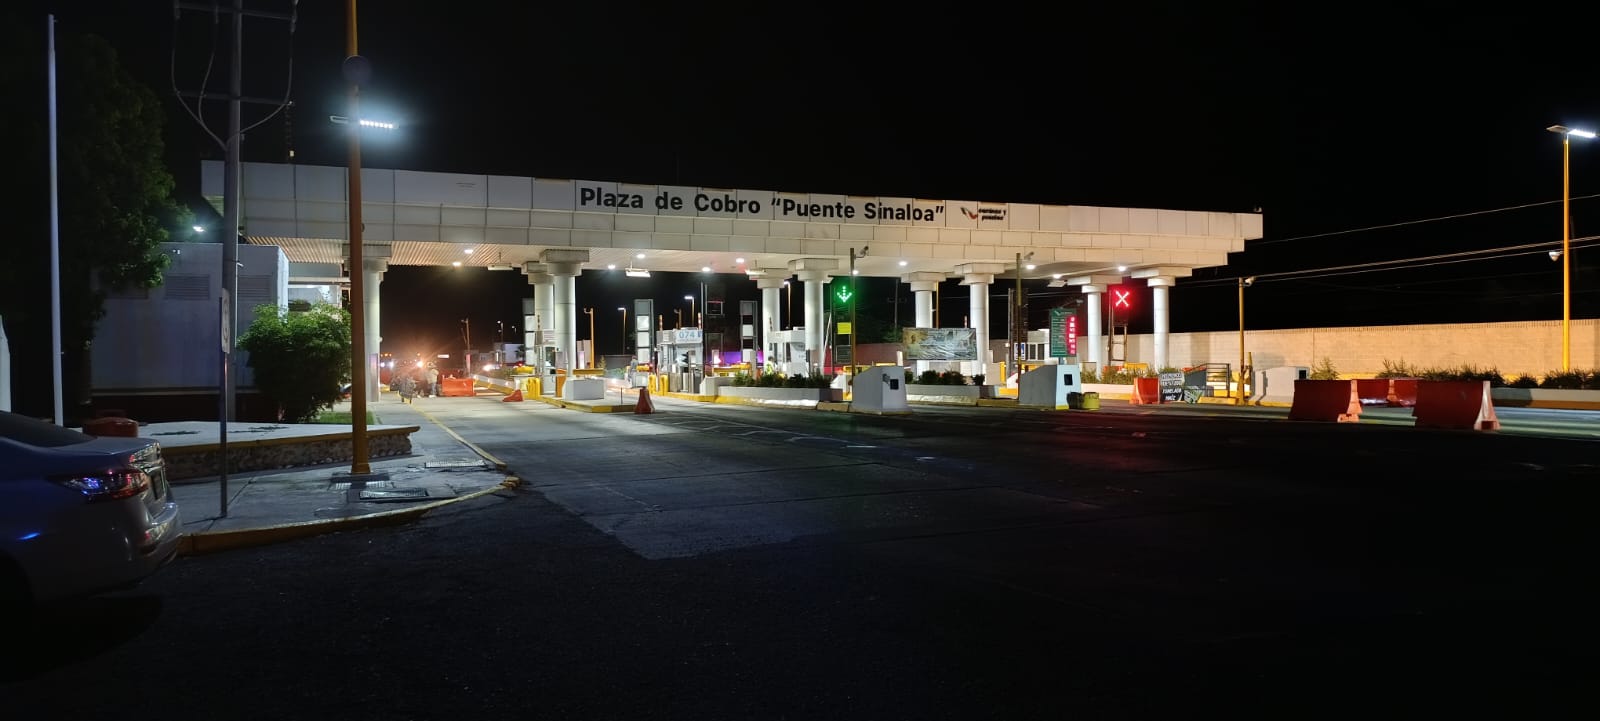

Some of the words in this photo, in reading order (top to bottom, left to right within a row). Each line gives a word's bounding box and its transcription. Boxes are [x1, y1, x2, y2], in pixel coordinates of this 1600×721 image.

[580, 187, 644, 208] Plaza
[655, 191, 683, 210] de
[694, 193, 761, 214] Cobro
